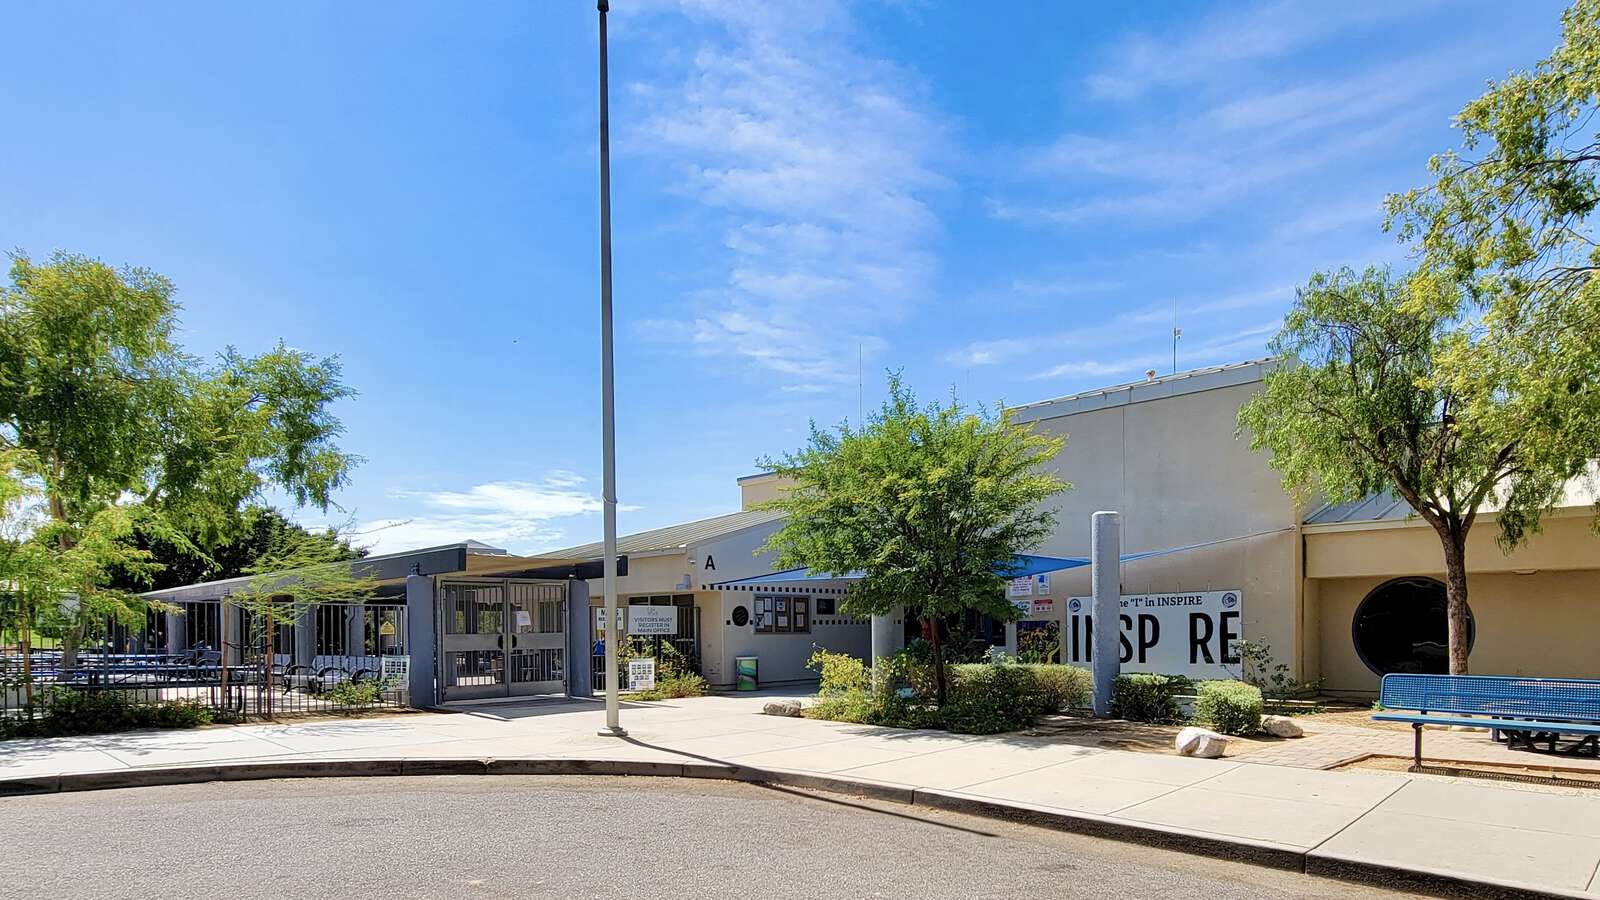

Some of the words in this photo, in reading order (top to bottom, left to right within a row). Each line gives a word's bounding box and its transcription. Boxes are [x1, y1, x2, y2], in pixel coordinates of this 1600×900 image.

[705, 555, 716, 570] A
[1145, 597, 1155, 606] in
[1157, 595, 1203, 606] INSPIRE
